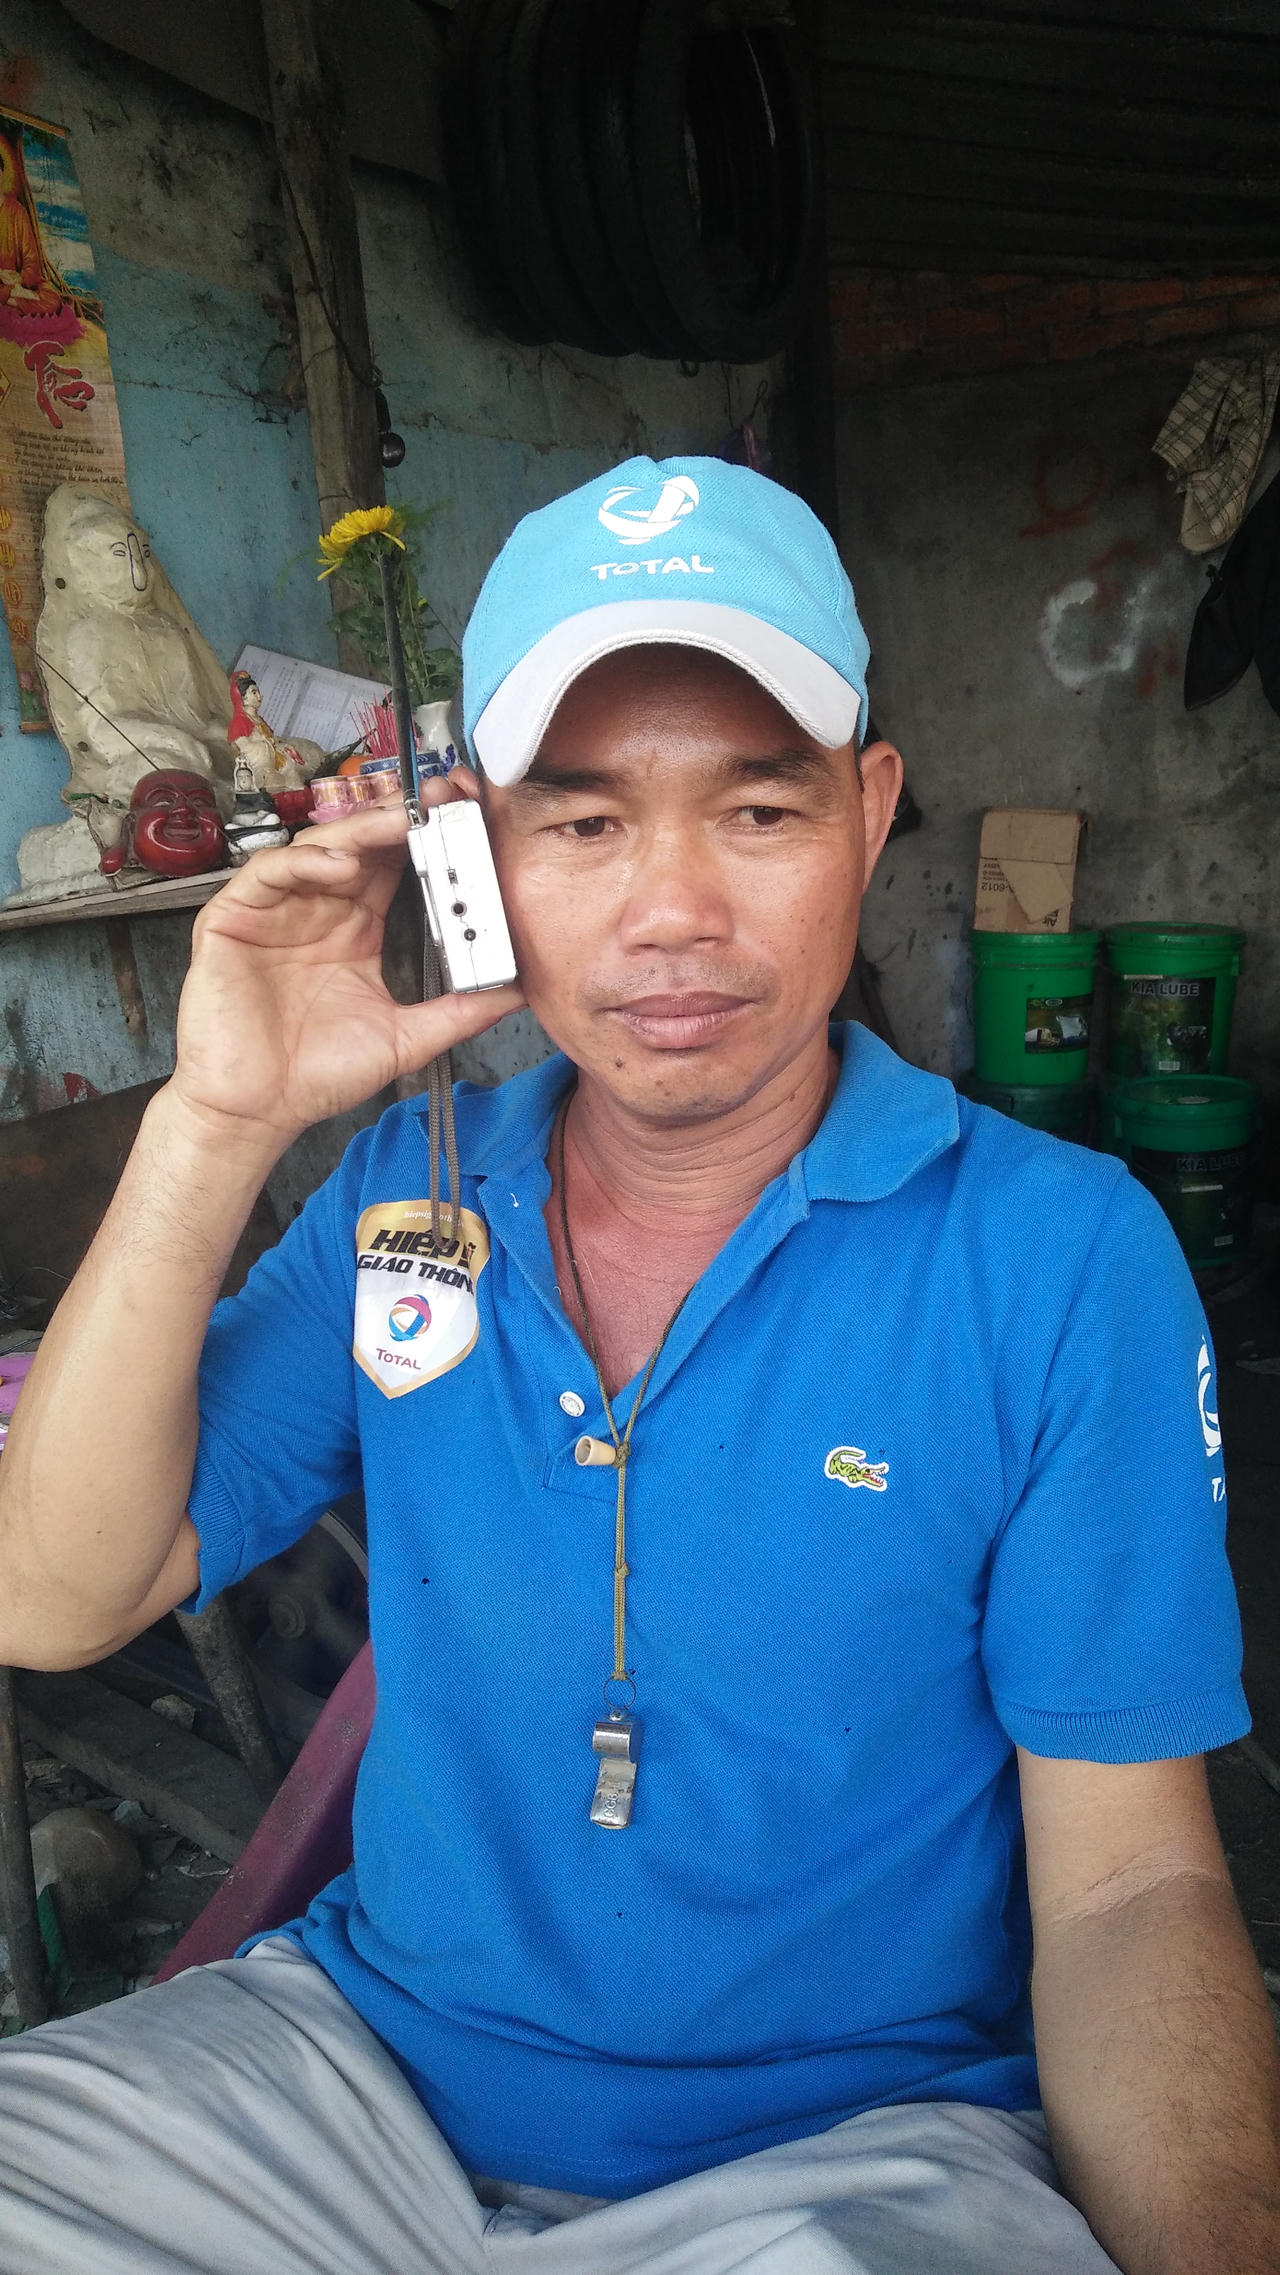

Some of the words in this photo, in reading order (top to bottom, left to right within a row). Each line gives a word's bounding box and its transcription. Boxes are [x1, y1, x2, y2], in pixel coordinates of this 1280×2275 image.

[590, 554, 715, 580] TOTAL
[1131, 982, 1155, 995] KIA
[1159, 983, 1201, 997] LUBE
[1176, 1157, 1207, 1172] KIA
[376, 1348, 421, 1371] TOTAL
